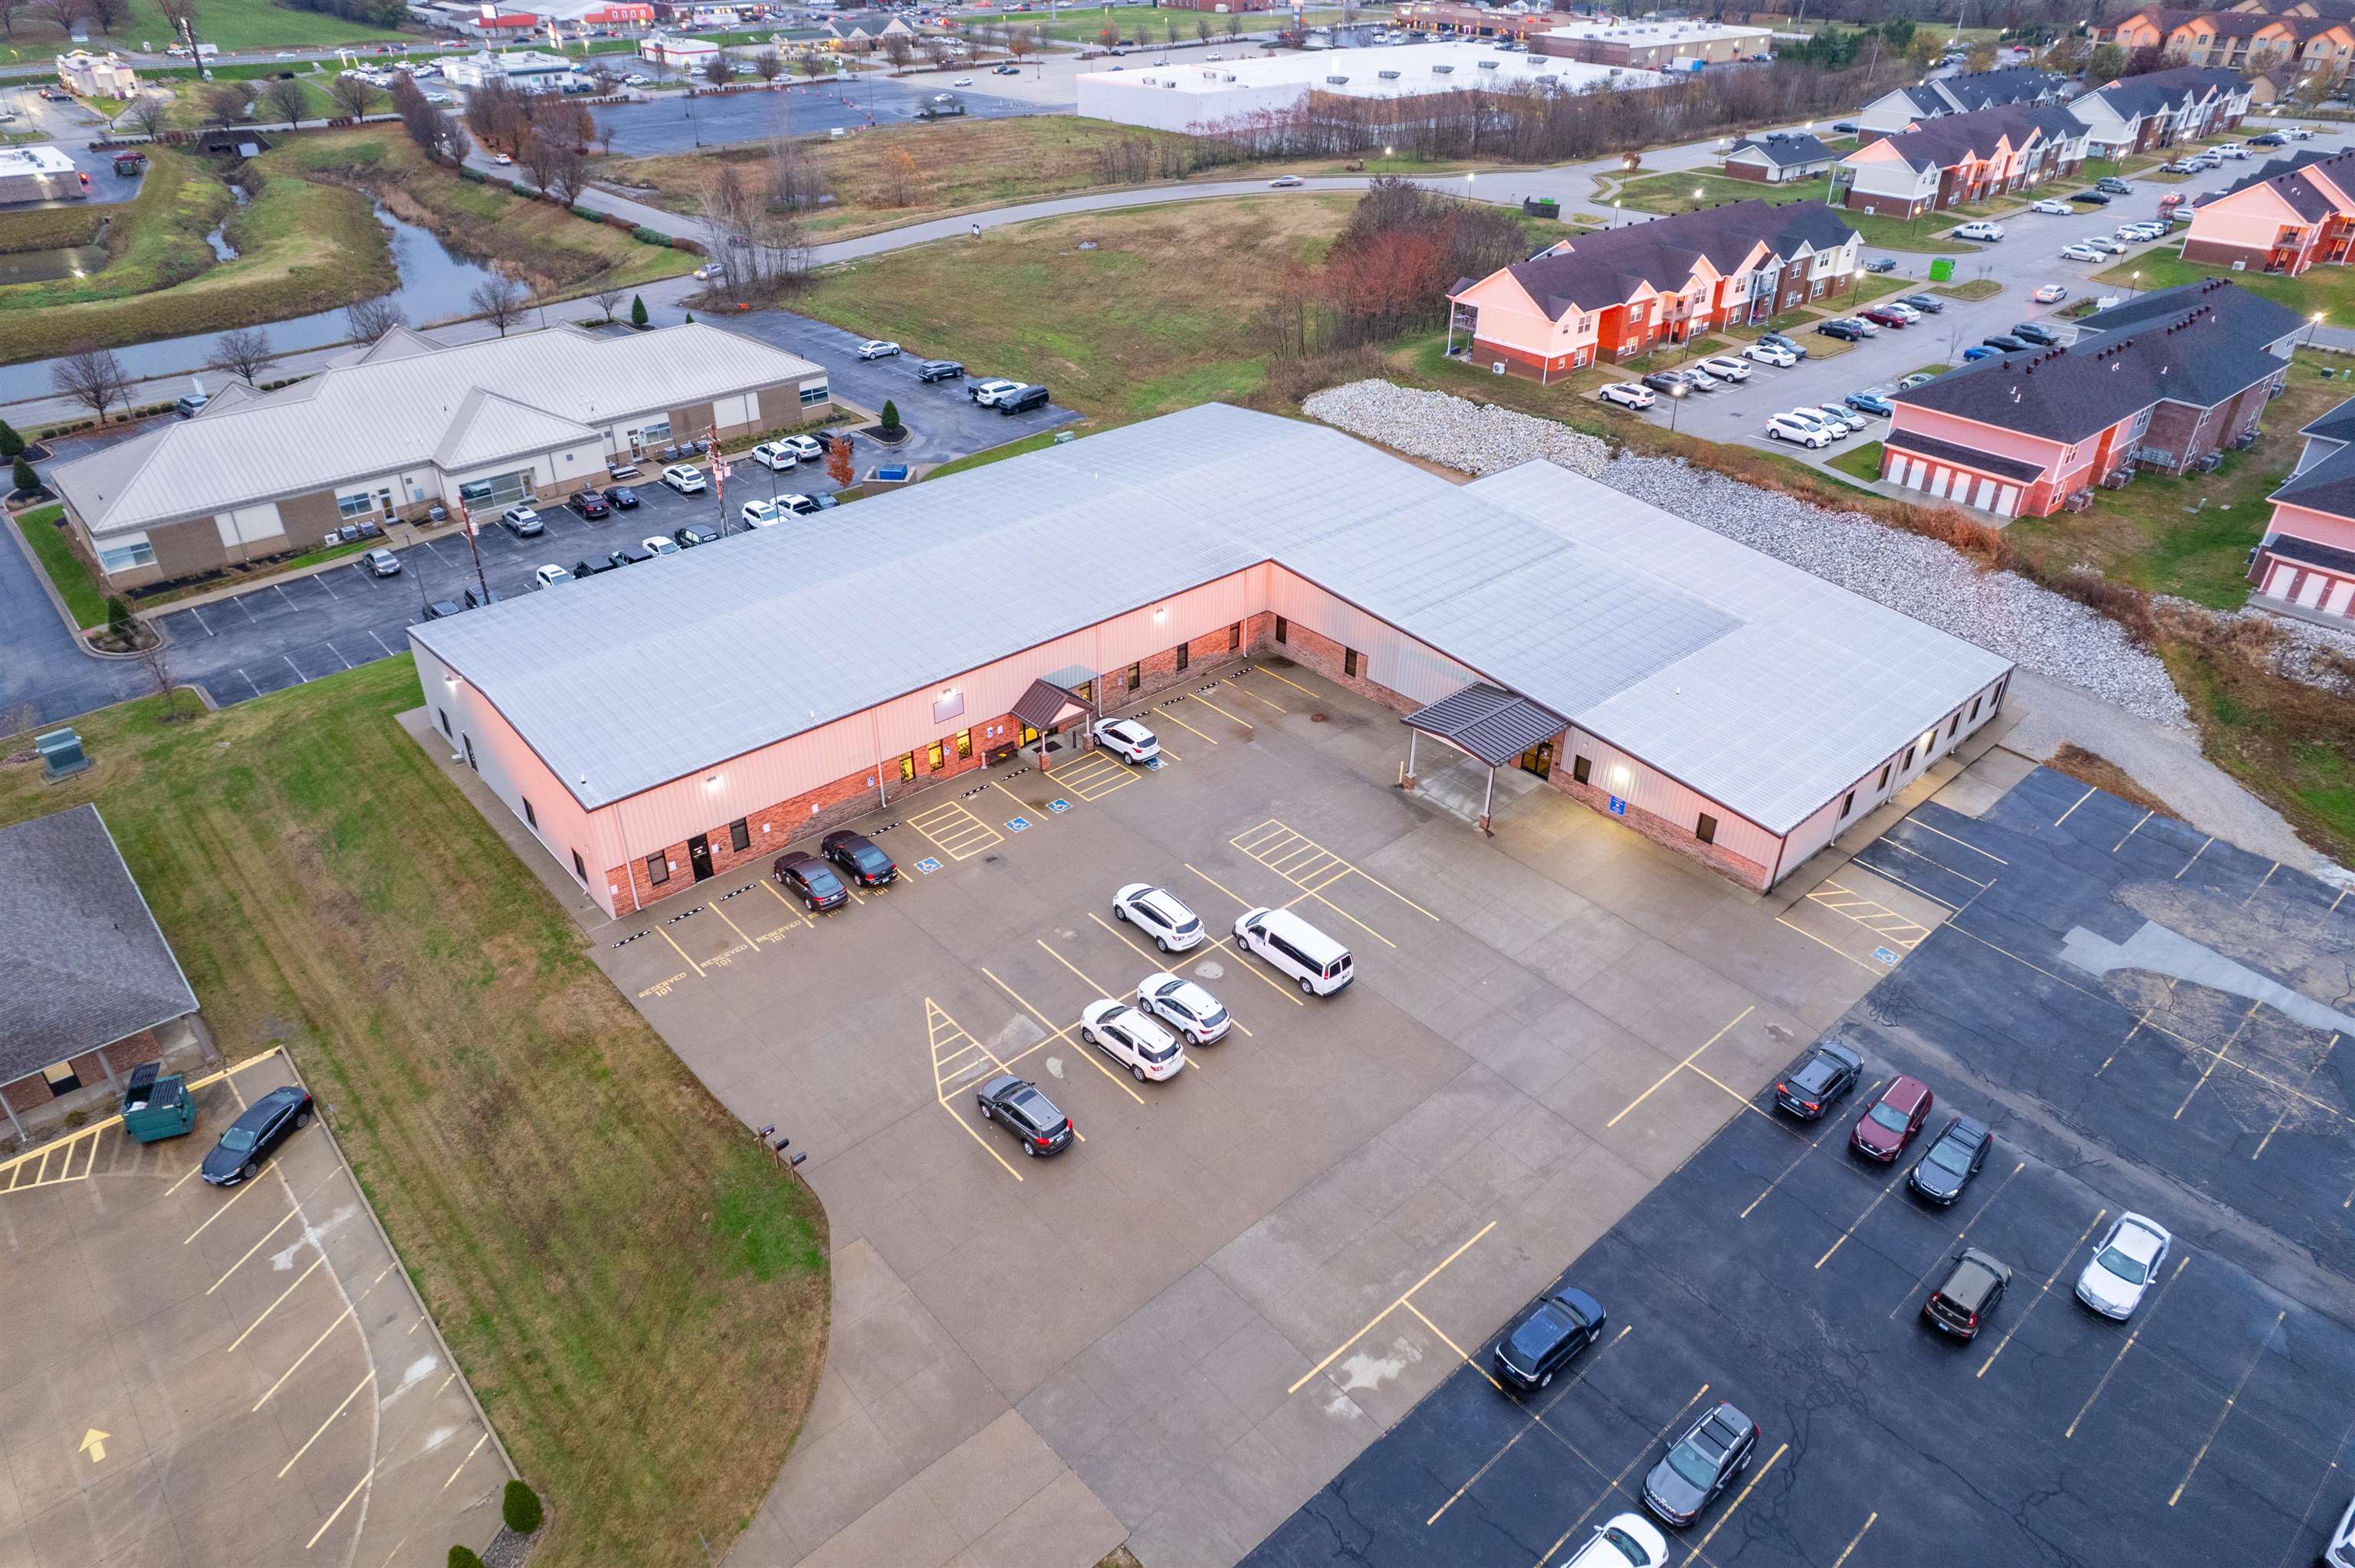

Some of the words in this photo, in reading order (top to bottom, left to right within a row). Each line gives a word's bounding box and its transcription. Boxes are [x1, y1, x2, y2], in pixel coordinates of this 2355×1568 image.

[756, 920, 801, 943] RESERVED
[770, 933, 785, 943] 101
[700, 944, 747, 968] RESERVED
[638, 972, 687, 998] RESERVED
[655, 986, 673, 997] 101
